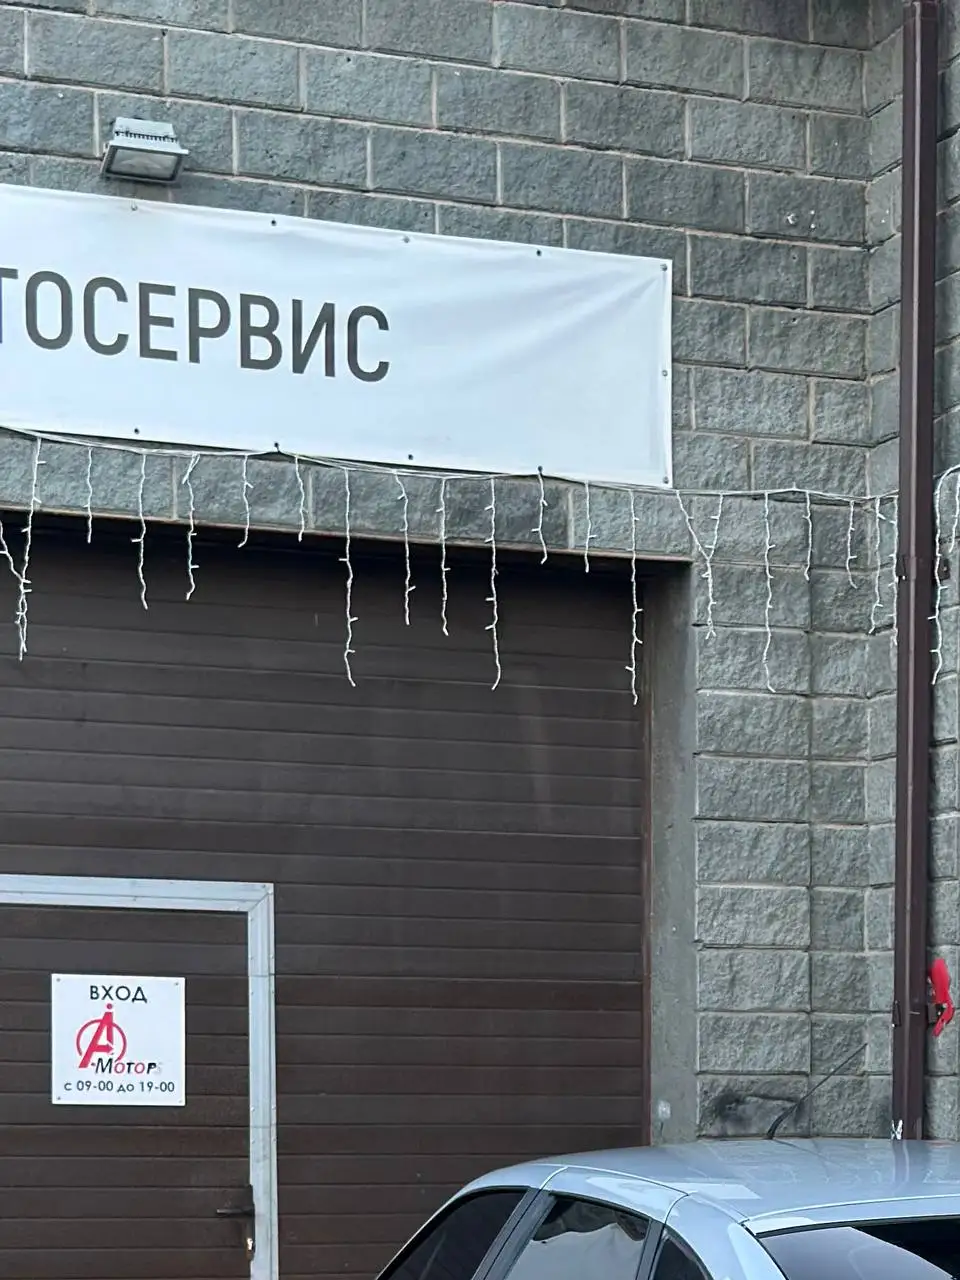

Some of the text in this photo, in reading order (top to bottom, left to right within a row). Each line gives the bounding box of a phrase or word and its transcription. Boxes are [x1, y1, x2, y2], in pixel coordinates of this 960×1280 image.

[89, 985, 147, 1002] ВХОД
[76, 1080, 114, 1092] 09-00
[117, 1084, 135, 1093] до
[139, 1081, 176, 1093] 19-00
